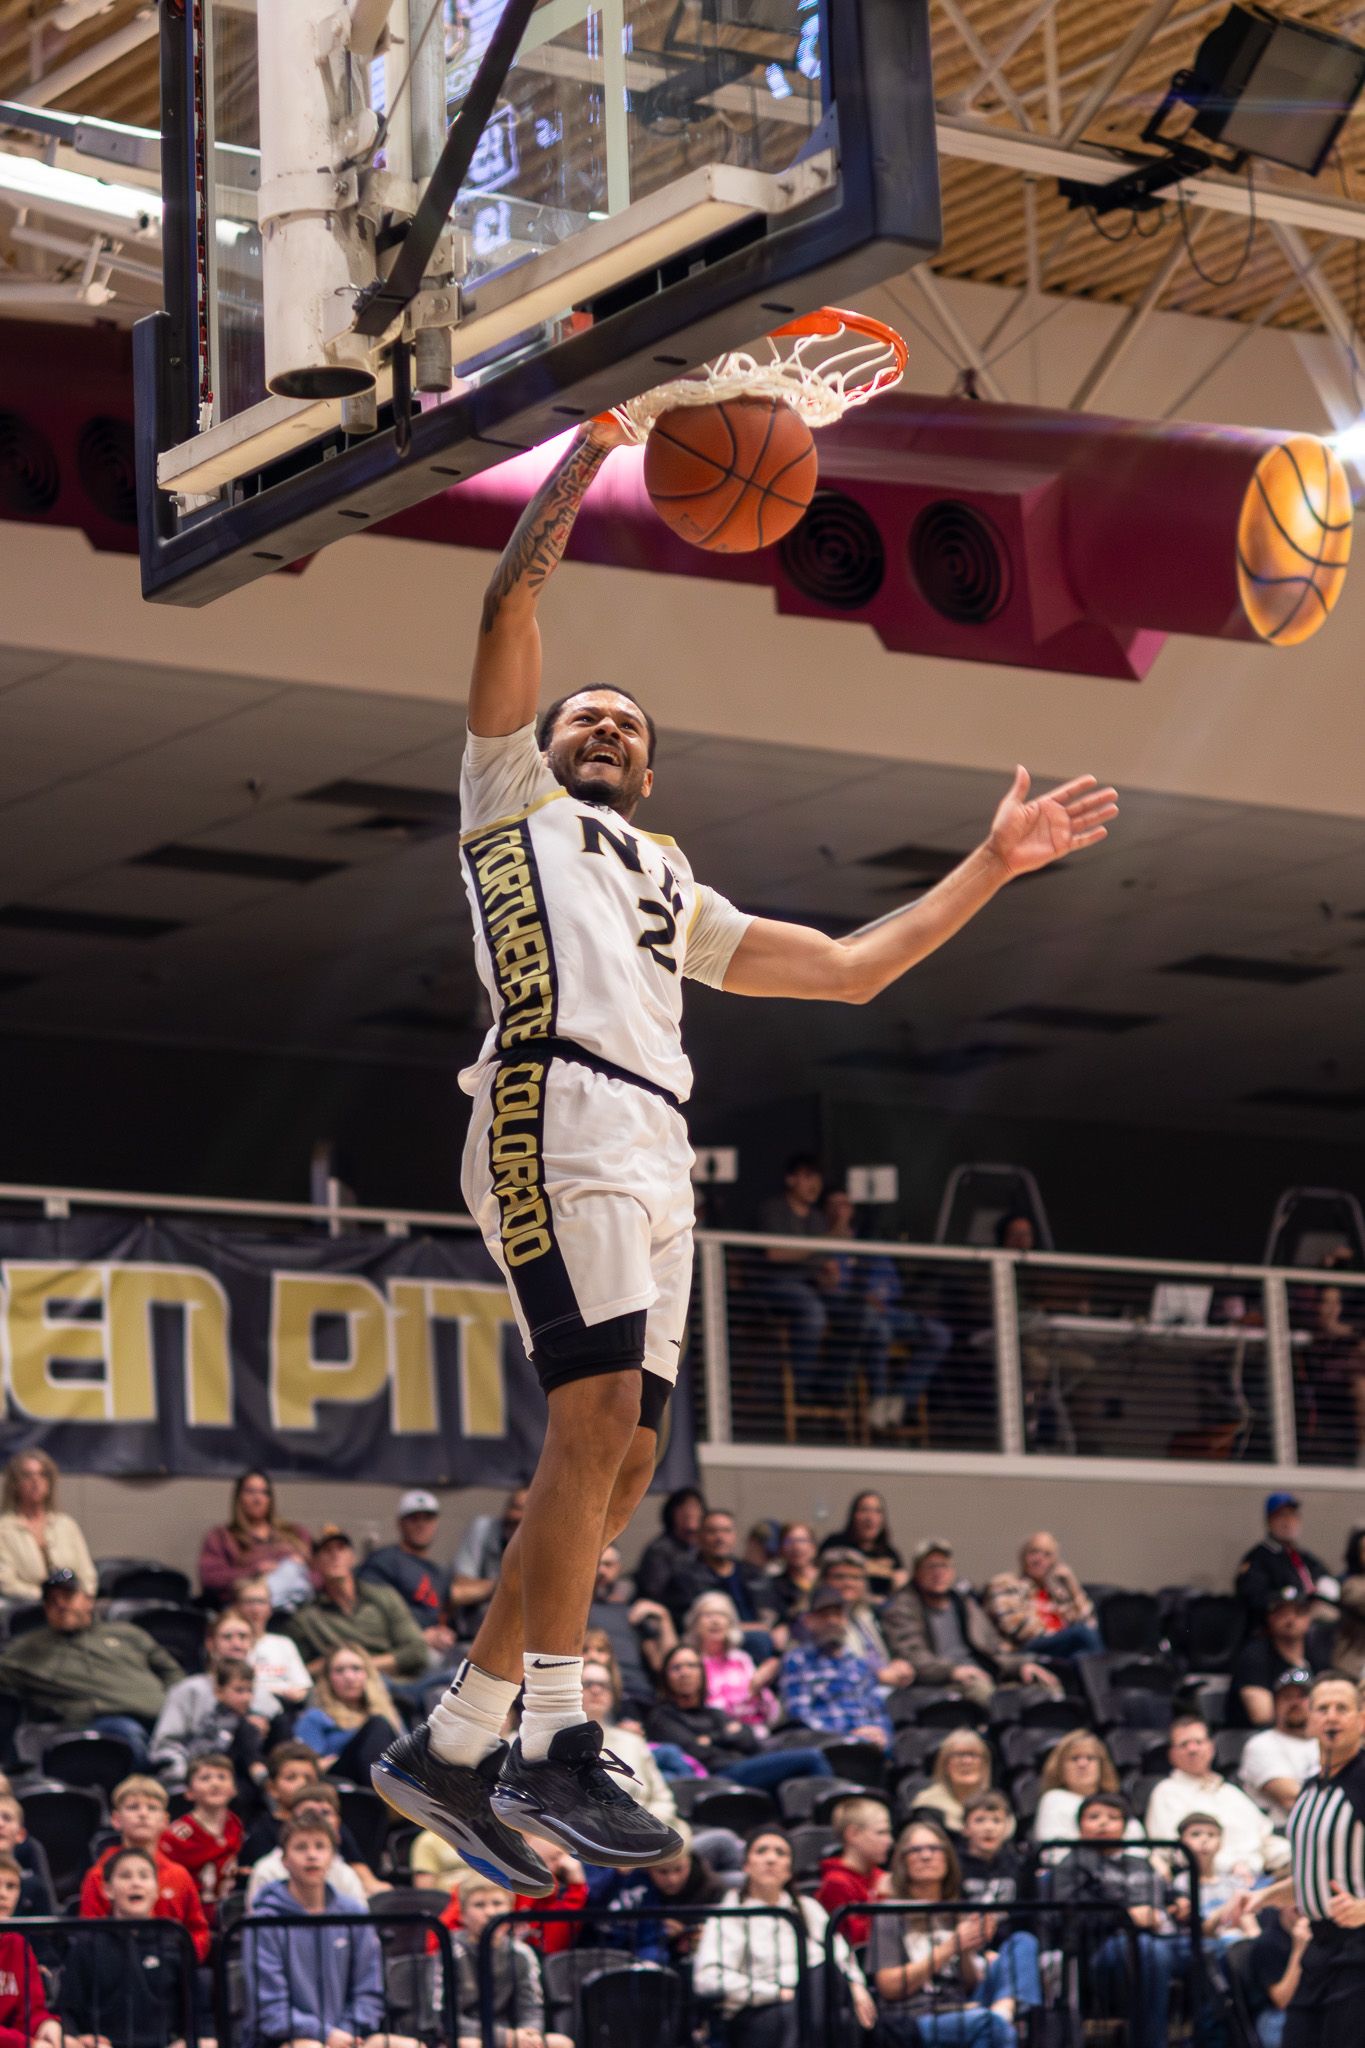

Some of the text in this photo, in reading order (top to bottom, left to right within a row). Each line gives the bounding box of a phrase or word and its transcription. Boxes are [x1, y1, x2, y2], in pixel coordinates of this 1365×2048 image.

[637, 898, 678, 975] 2
[492, 1062, 551, 1267] COLORADO
[0, 1259, 518, 1438] EN PIT
